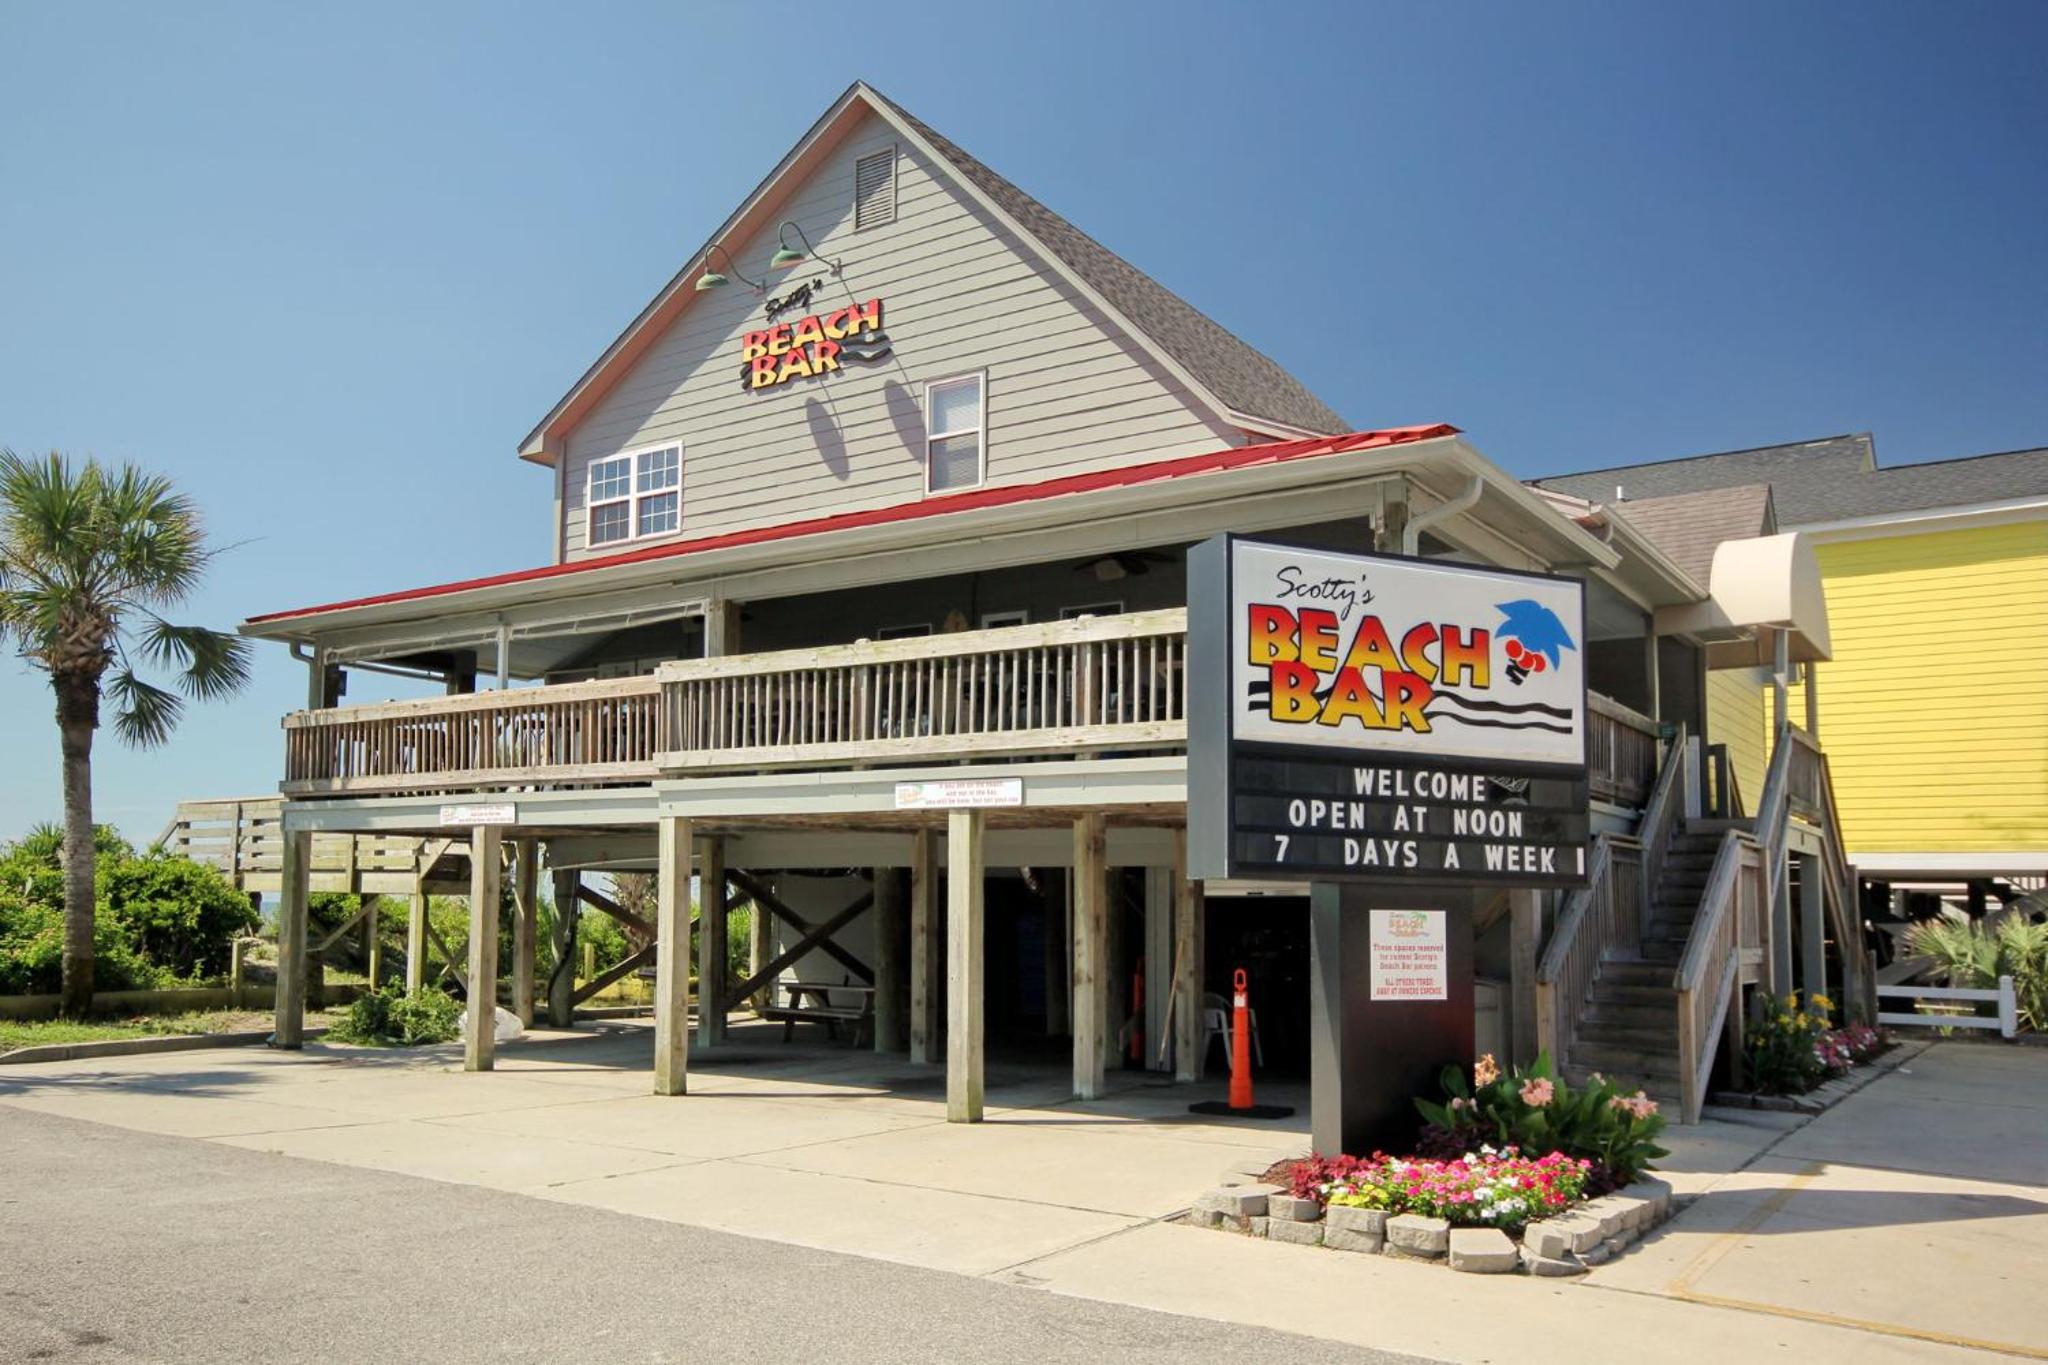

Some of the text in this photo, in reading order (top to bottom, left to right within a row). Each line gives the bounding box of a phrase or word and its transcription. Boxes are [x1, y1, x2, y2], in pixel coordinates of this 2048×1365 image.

[742, 297, 882, 363] BEACH
[752, 340, 842, 389] BAR
[1276, 565, 1376, 620] Scotty's
[1247, 602, 1490, 690] BEACH
[1269, 660, 1433, 733] BAR
[1354, 768, 1486, 802] WELCOME
[1288, 800, 1523, 837] OPEN AT NOON
[1274, 835, 1289, 862] 7
[1344, 839, 1418, 868] DAYS
[1444, 844, 1460, 869] A
[1485, 847, 1555, 874] WEEK
